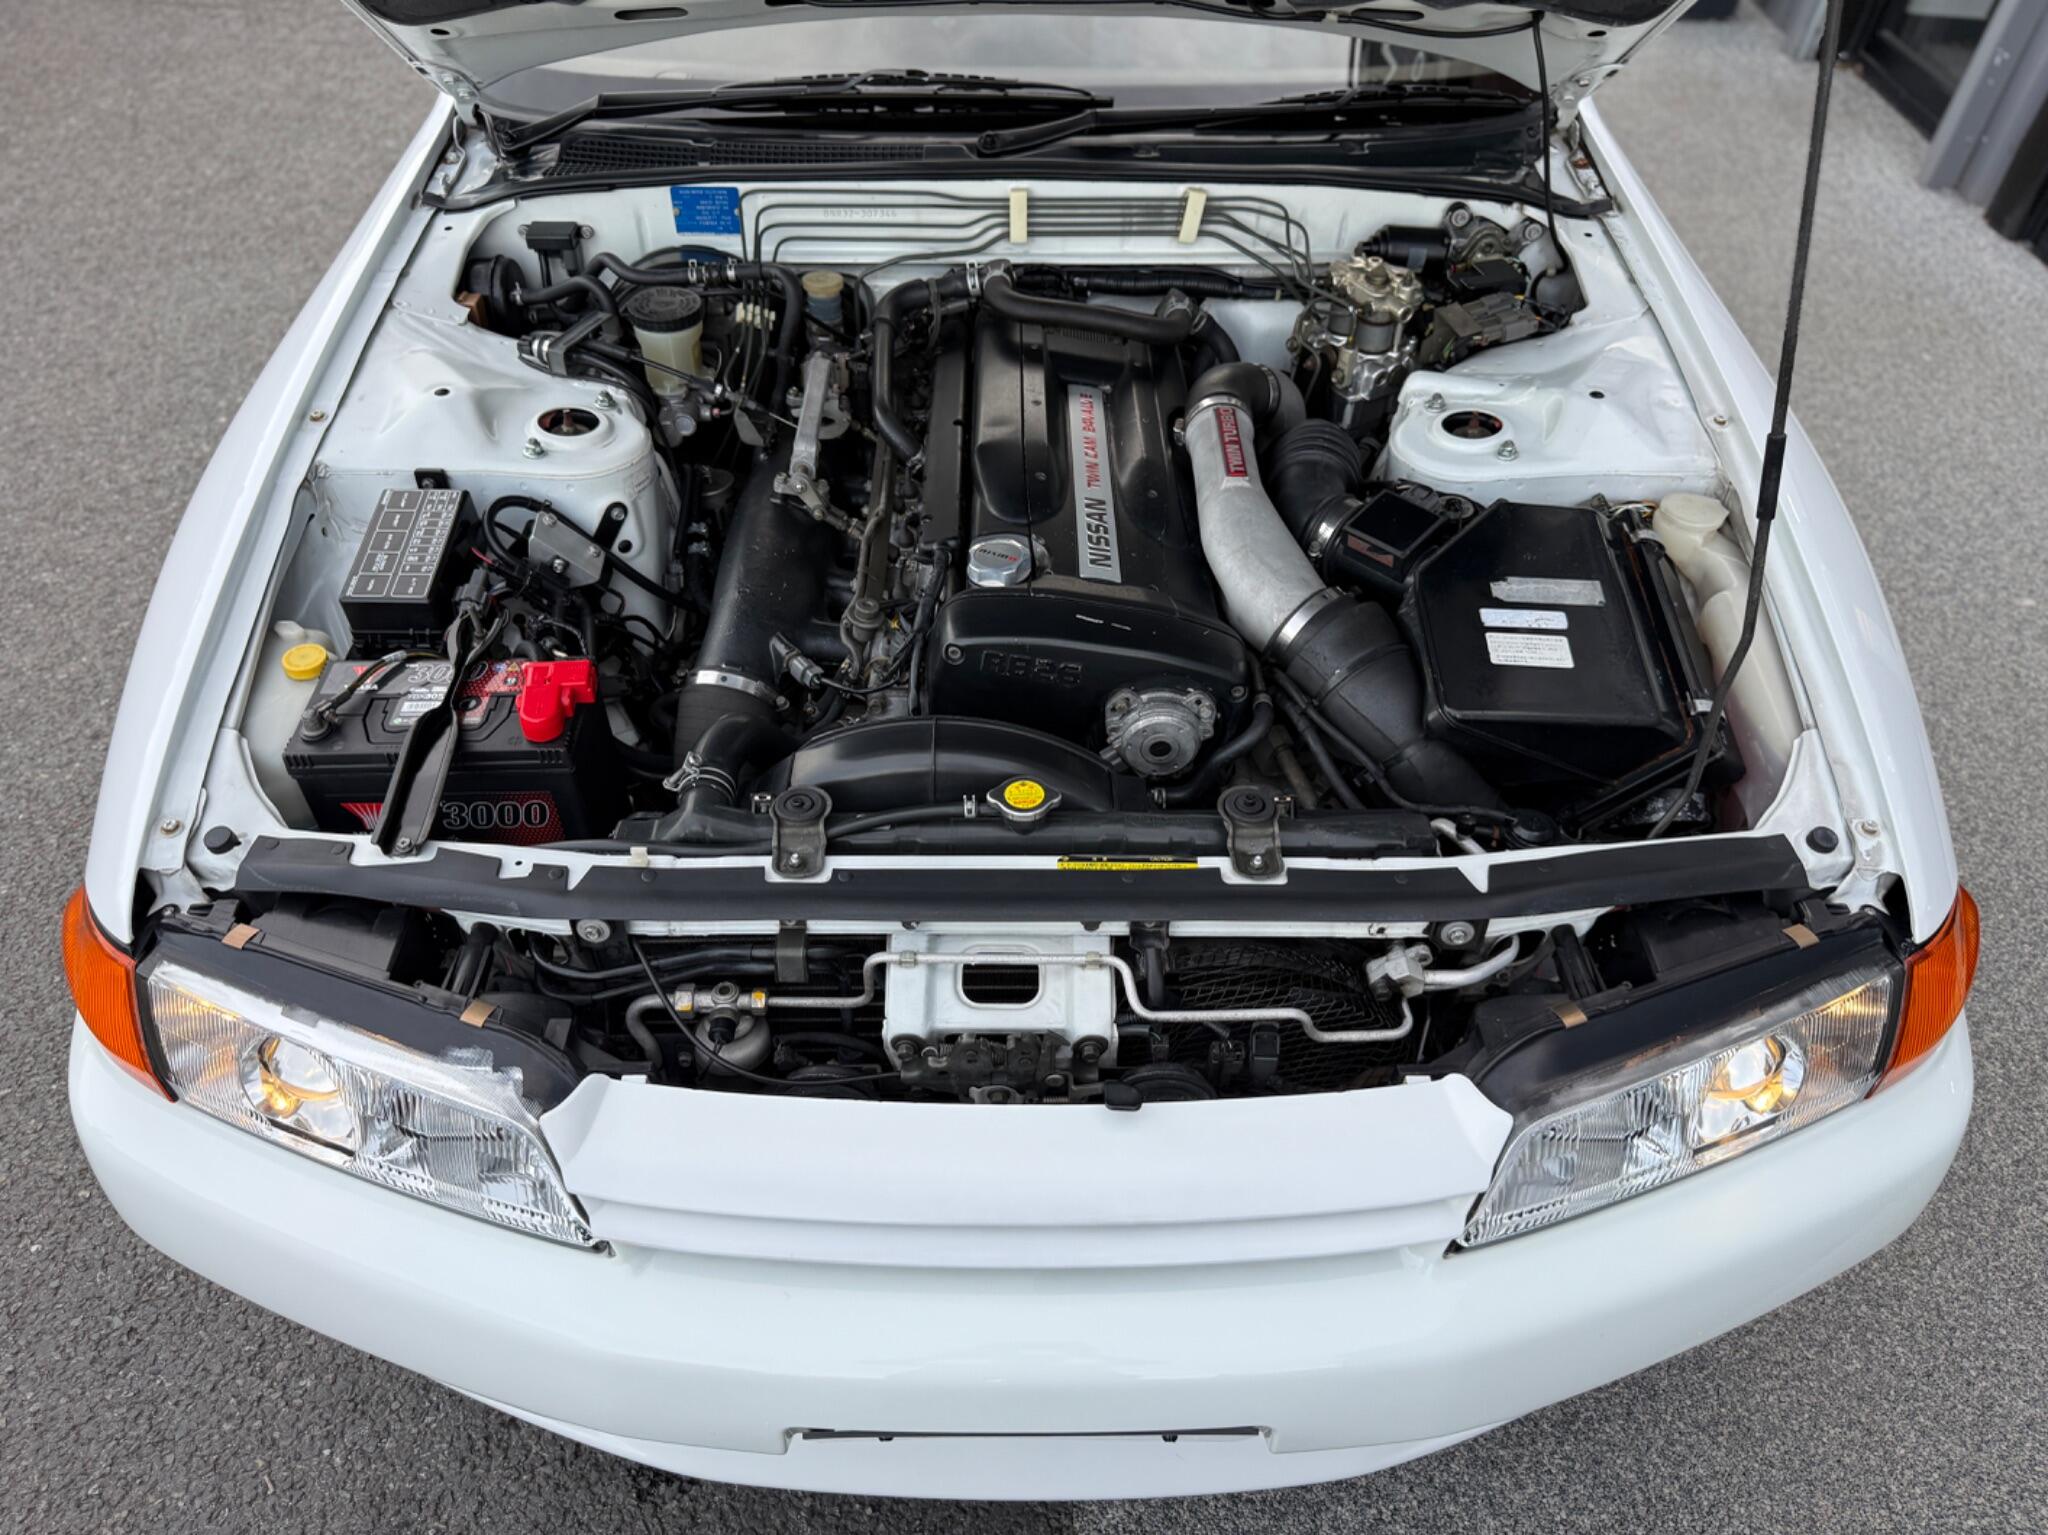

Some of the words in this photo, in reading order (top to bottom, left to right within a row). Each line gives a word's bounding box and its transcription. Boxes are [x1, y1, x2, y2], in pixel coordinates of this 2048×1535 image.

[1220, 408, 1240, 442] TURBO
[1083, 436, 1099, 459] CAM
[1224, 444, 1246, 473] TWIN
[1085, 461, 1102, 489] TWIN
[1084, 496, 1112, 569] NISSAN
[442, 800, 550, 830] 3000
